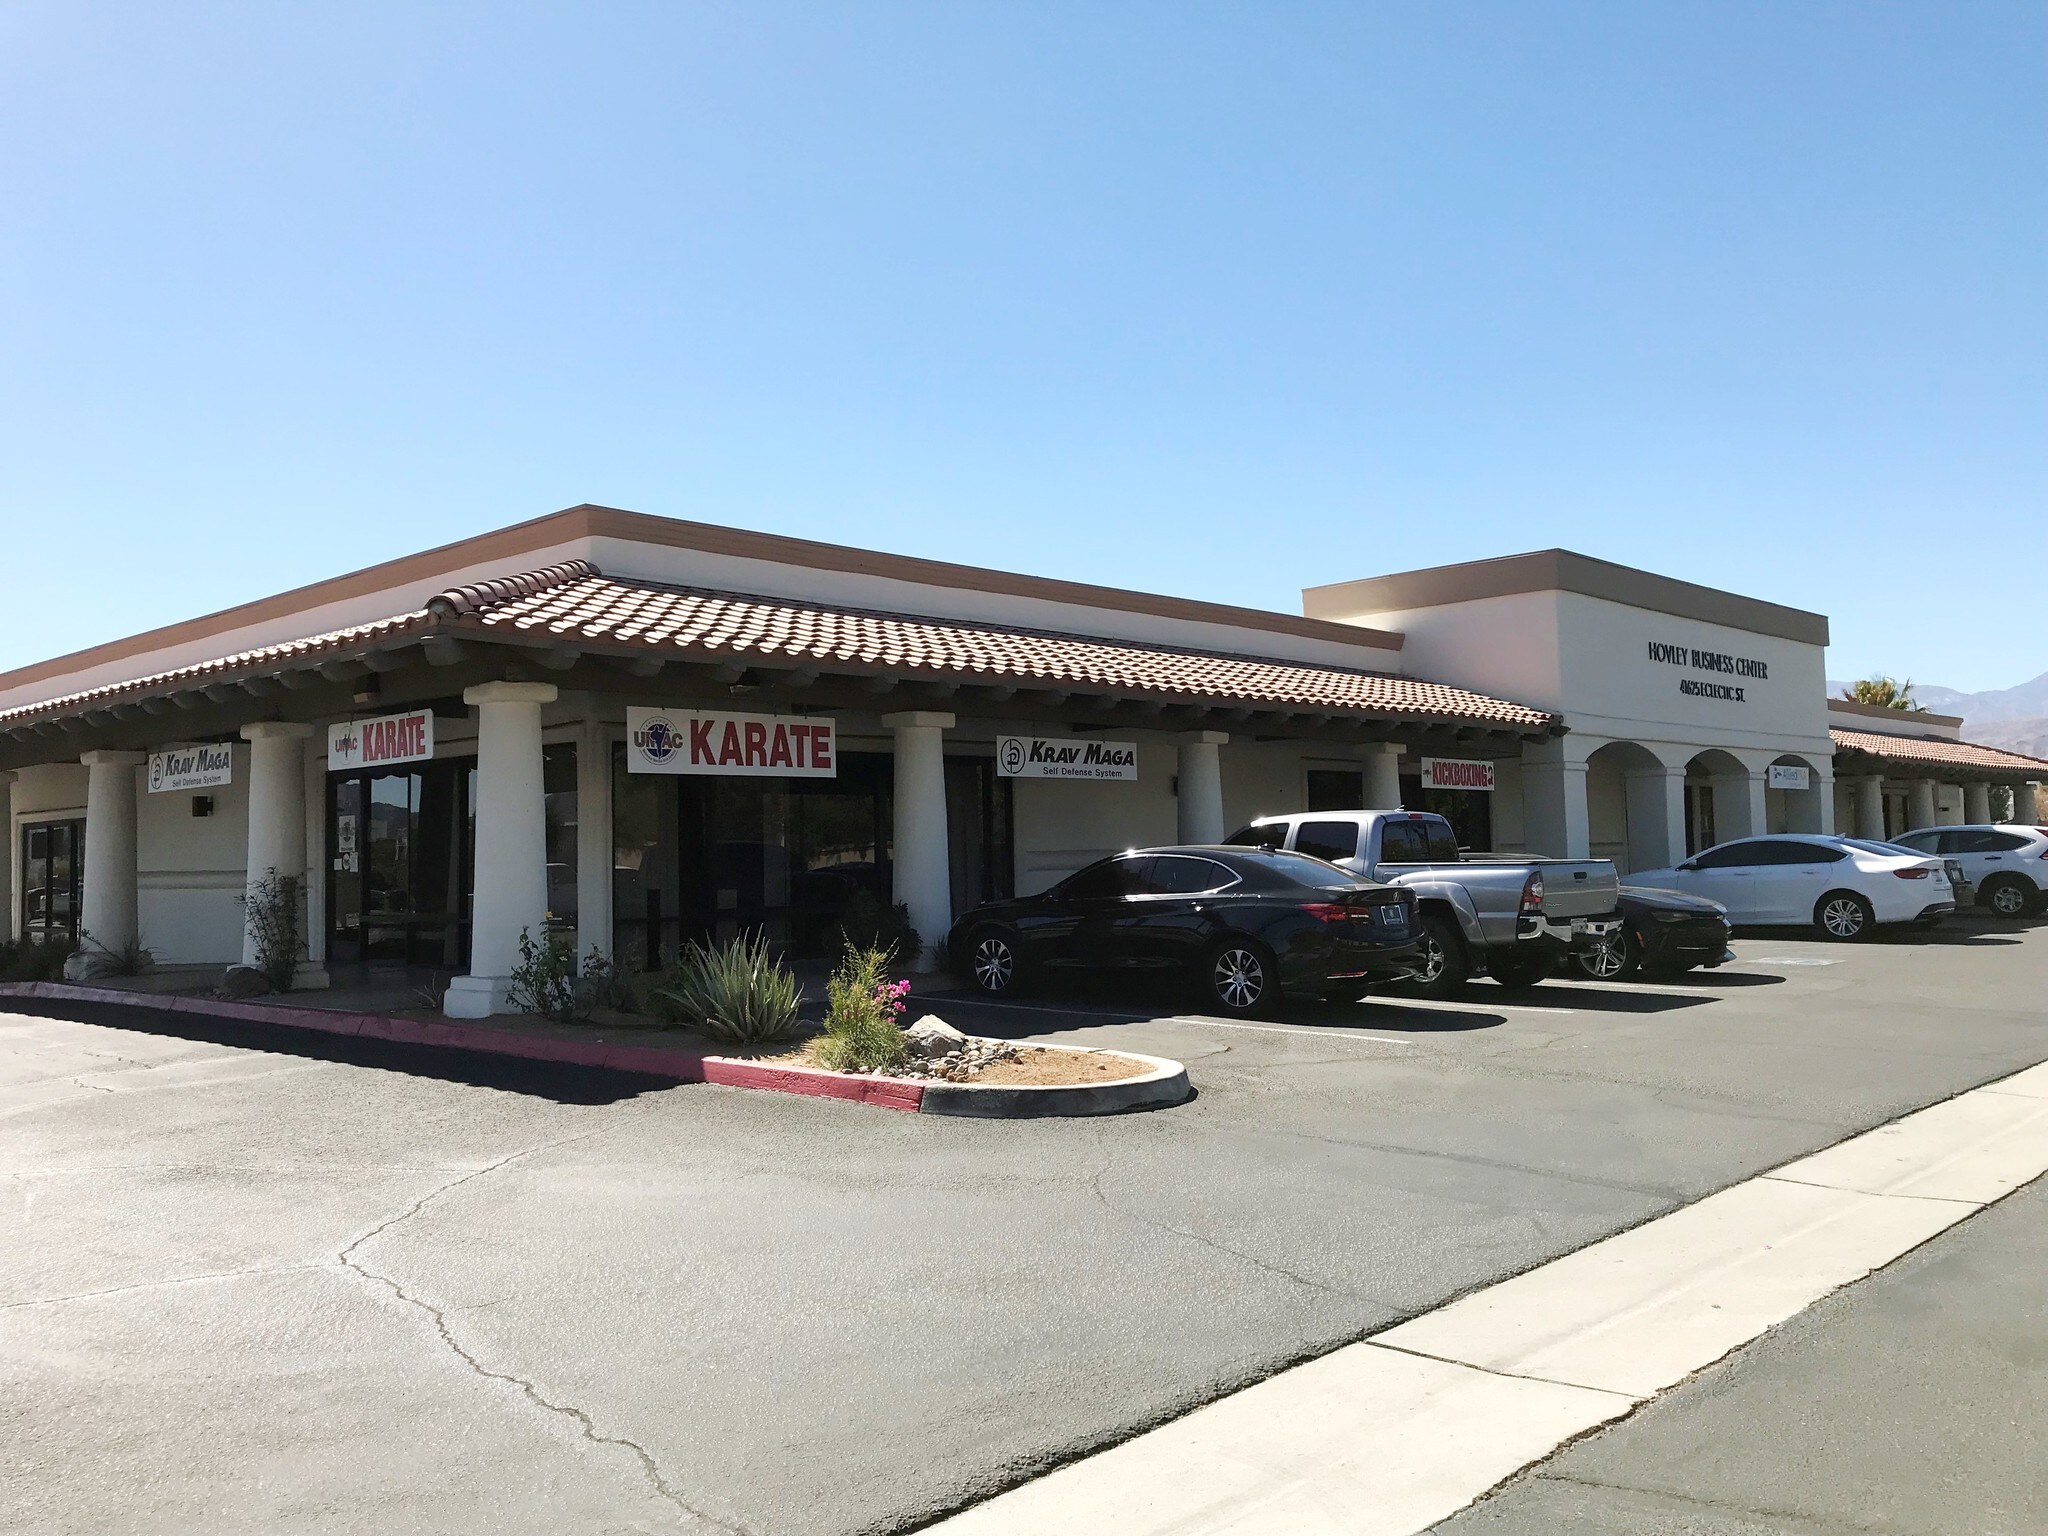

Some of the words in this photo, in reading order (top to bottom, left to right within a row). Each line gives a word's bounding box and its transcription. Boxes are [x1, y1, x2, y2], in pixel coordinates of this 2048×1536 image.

[1648, 641, 1688, 666] HOVLEY
[1691, 649, 1734, 674] BUSINESS
[1736, 657, 1768, 680] CENTER
[362, 715, 426, 762] KARATE
[690, 719, 832, 768] KARATE
[203, 775, 222, 785] System
[1043, 767, 1058, 775] Self
[1061, 767, 1093, 776] Defense
[1095, 769, 1122, 778] System
[1432, 761, 1488, 787] KICKBOXING
